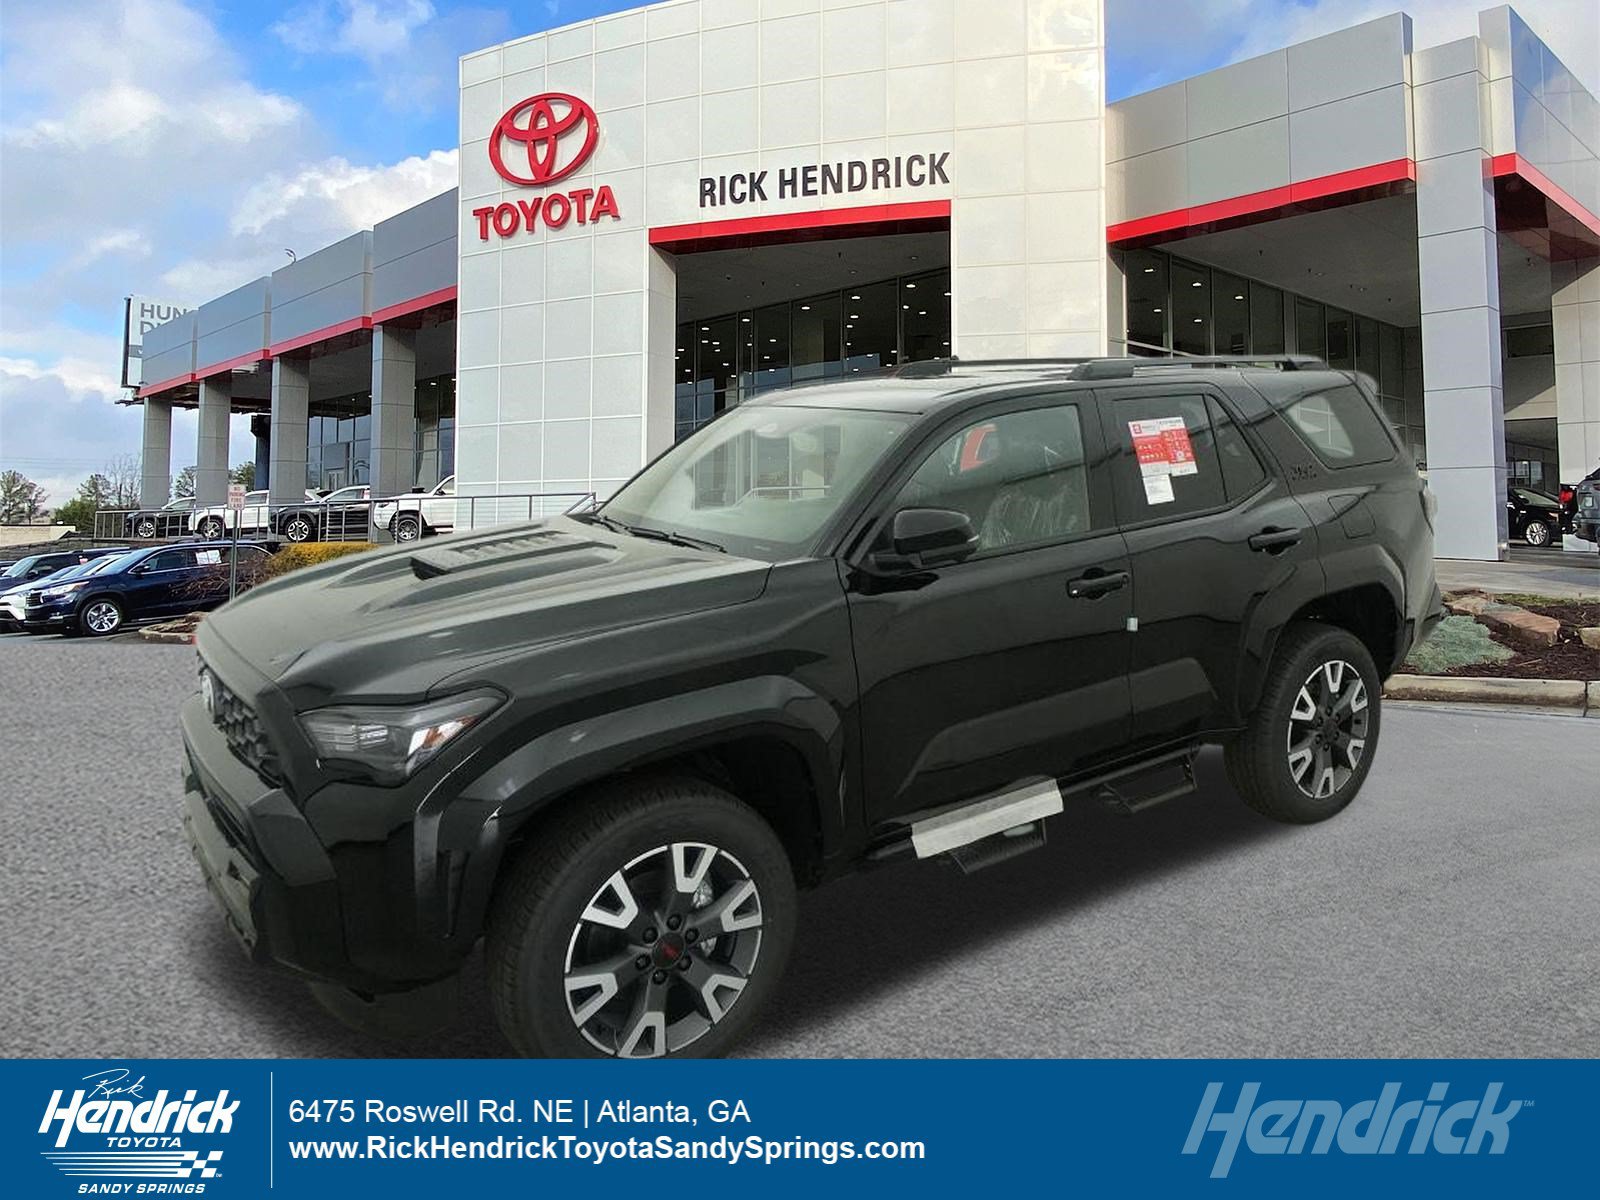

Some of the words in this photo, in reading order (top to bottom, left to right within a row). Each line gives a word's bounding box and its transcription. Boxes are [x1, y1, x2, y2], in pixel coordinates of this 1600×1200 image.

[699, 171, 768, 208] RICK
[779, 152, 950, 200] HENDRICK
[472, 186, 621, 240] TOYOTA
